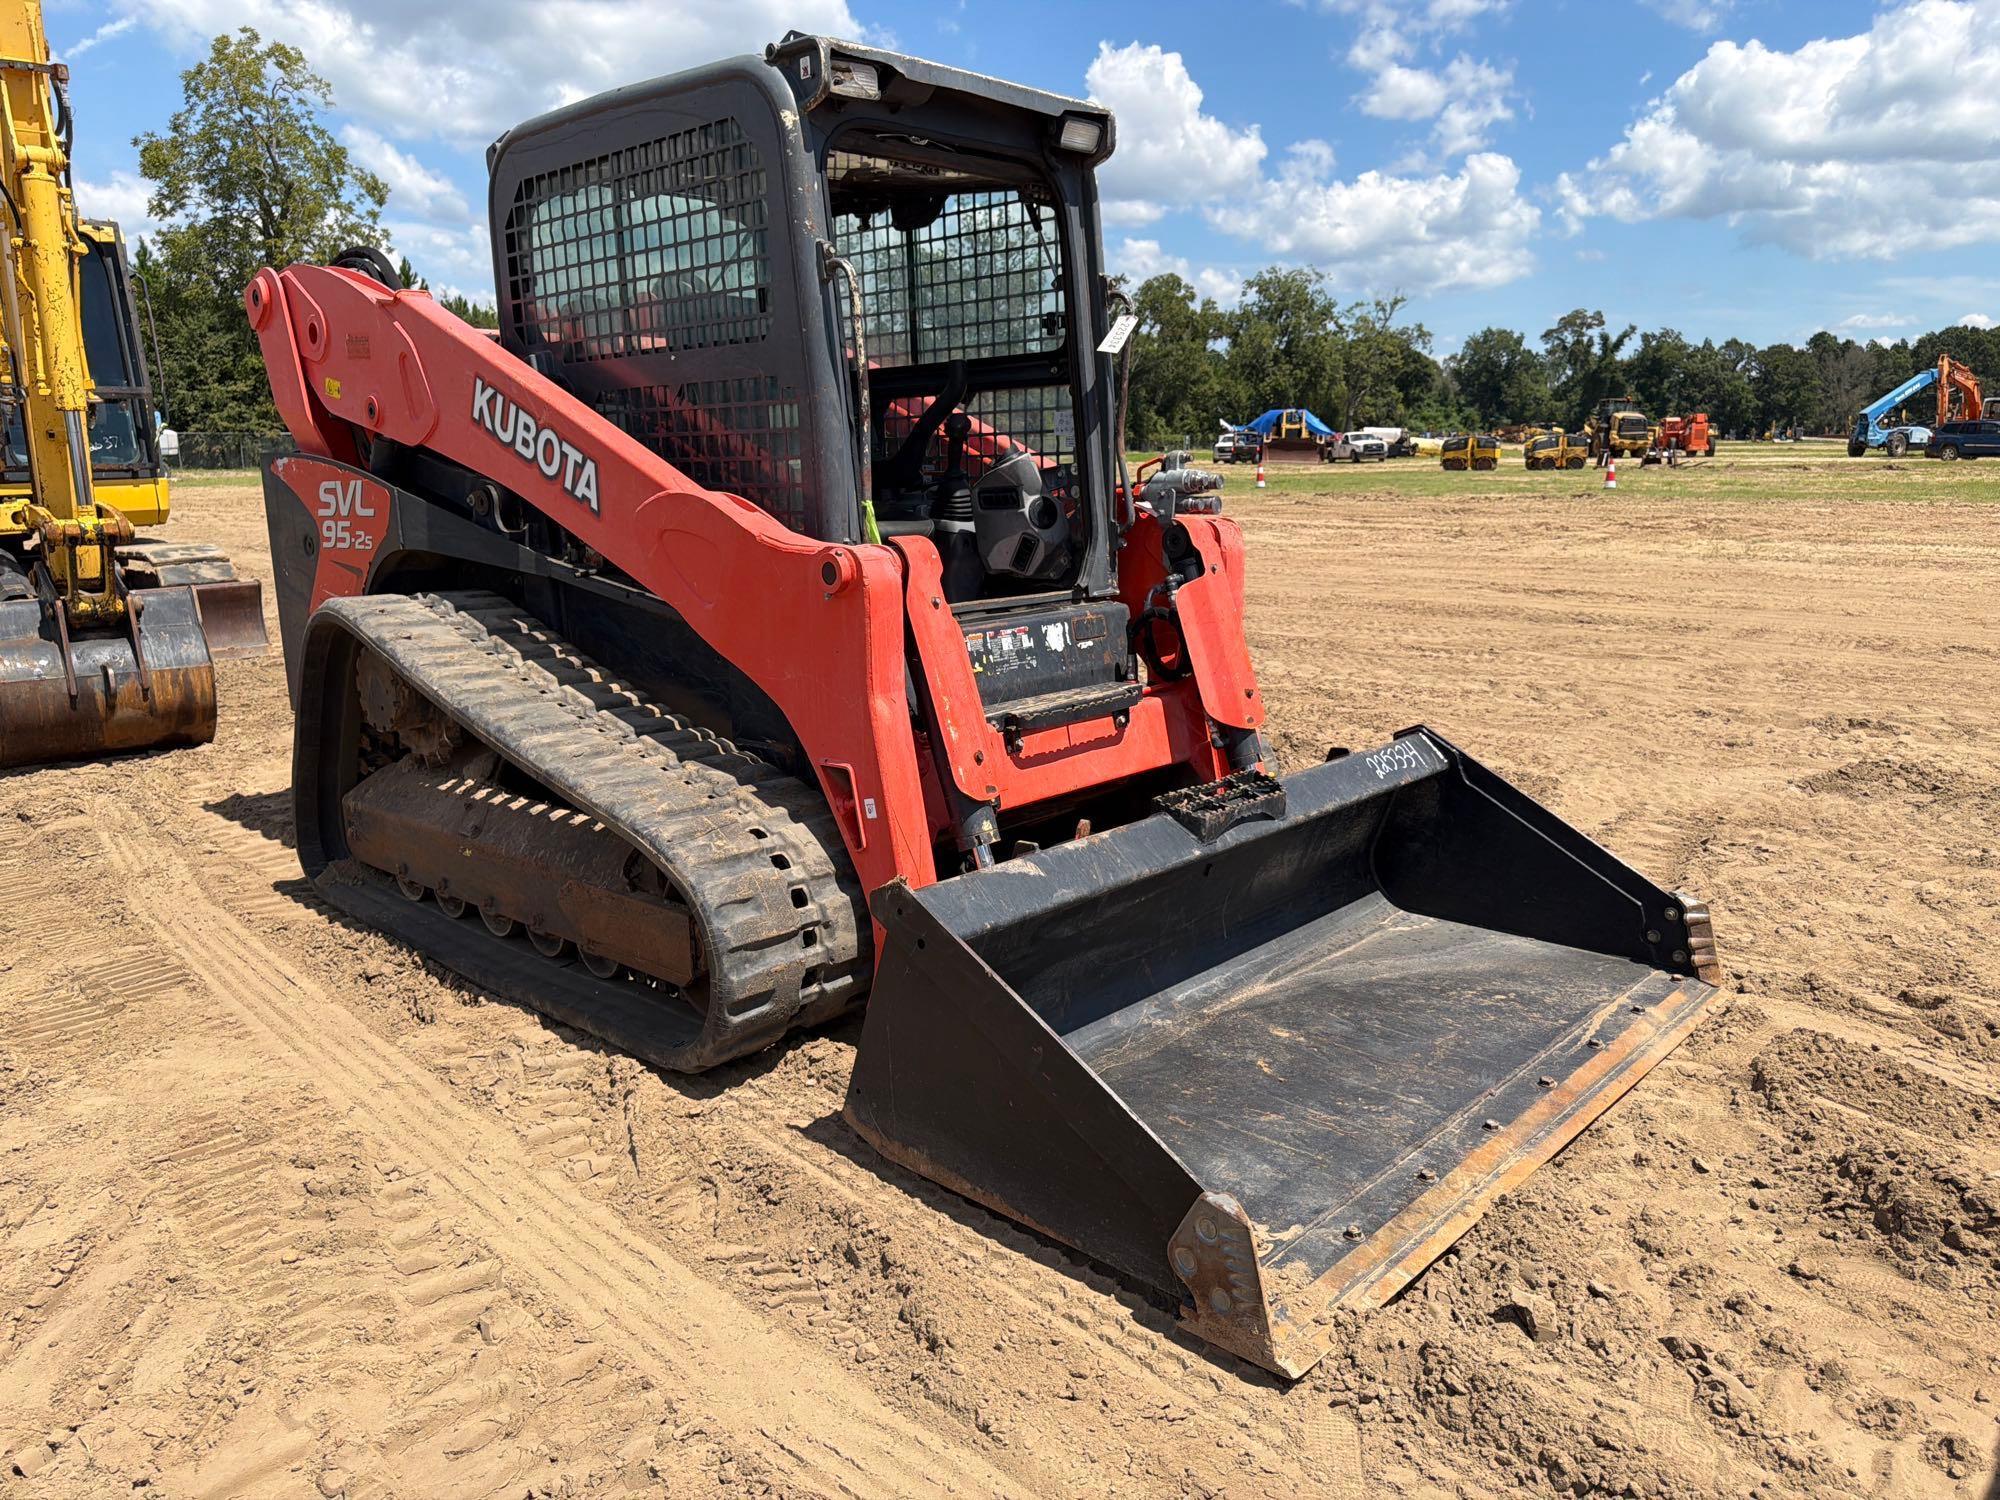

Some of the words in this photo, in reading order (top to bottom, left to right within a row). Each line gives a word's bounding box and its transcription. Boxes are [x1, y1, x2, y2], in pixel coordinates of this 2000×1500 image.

[472, 376, 600, 514] KUBOTA
[317, 479, 375, 517] SVL
[1365, 740, 1429, 780] 225334
